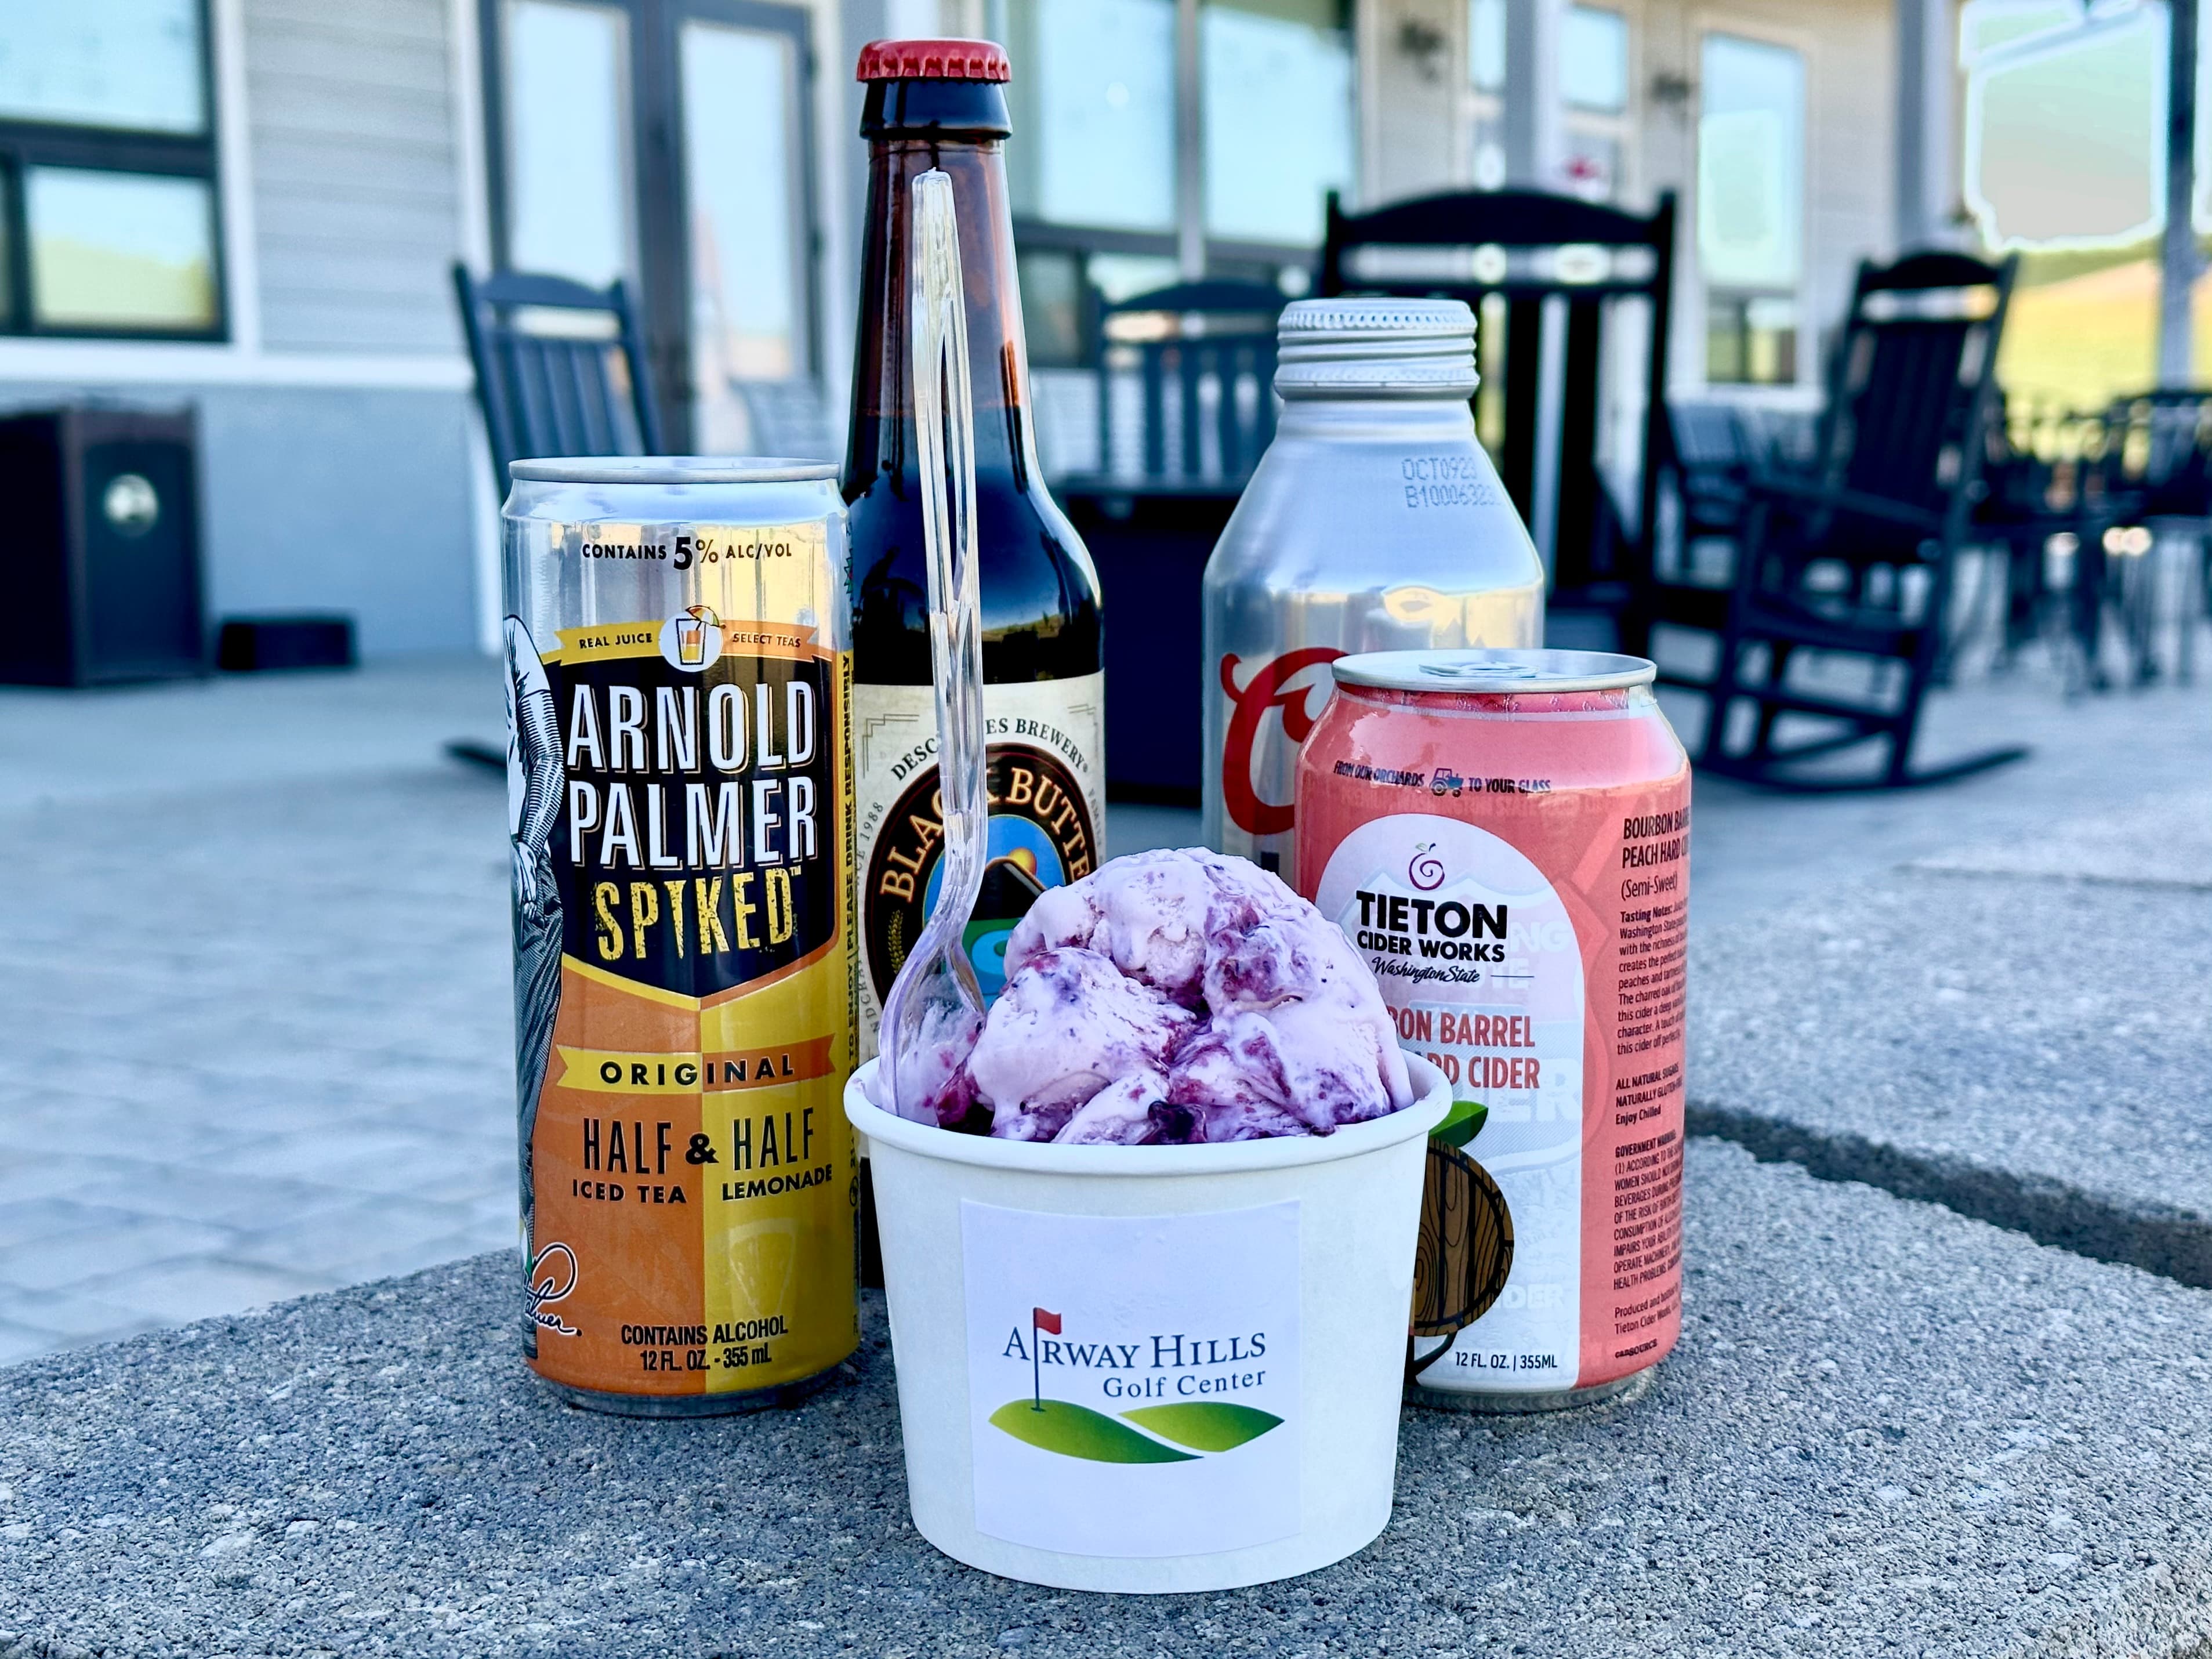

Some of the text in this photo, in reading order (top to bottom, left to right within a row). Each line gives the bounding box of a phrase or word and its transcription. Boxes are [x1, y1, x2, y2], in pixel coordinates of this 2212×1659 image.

[582, 536, 792, 571] CONTAINS 5% ALC/VOL
[579, 632, 653, 650] REAL JUICE
[733, 632, 802, 649] SELECT TEAS
[567, 680, 818, 775] ARNOLD
[843, 654, 853, 796] RESPONSIBLY
[891, 717, 1009, 781] DESCES
[1333, 759, 1551, 794] FROM OUR ORCHARDS TO YOUR GLASS
[568, 776, 818, 870] PALMER
[844, 800, 853, 867] DRINK
[860, 801, 884, 842] 1988
[1623, 812, 1673, 840] BOURBON
[880, 767, 1001, 904] BLA
[1622, 842, 1658, 869] PEACH
[1660, 838, 1680, 864] HARD
[1620, 870, 1678, 901] (Semi-Sweet)
[845, 872, 854, 952] PLEASE
[1355, 890, 1508, 940] TIETON
[1620, 908, 1651, 923] Tasting
[1619, 922, 1662, 940] Washington
[1357, 930, 1506, 963] CIDER WORKS
[1619, 943, 1638, 956] with
[1639, 940, 1652, 953] the
[1619, 959, 1647, 972] creates
[1648, 955, 1659, 968] the
[1618, 974, 1649, 991] peaches
[1651, 969, 1662, 983] and
[1618, 993, 1634, 1006] The
[1635, 988, 1660, 1004] charred
[1618, 1009, 1634, 1022] this
[1635, 1006, 1652, 1019] cider
[1439, 1012, 1536, 1048] BARREL
[1617, 1042, 1633, 1055] this
[1634, 1038, 1652, 1052] cider
[599, 1053, 795, 1086] ORIGINAL
[1467, 1056, 1540, 1089] CIDER
[1615, 1078, 1631, 1091] ALL
[1632, 1070, 1662, 1088] NATURAL
[1616, 1088, 1658, 1108] NATURALLY
[1615, 1104, 1661, 1126] Enjoy Chilled
[583, 1107, 814, 1175] HALF & HALF
[1615, 1136, 1657, 1158] GOVERNMENT
[1626, 1152, 1659, 1173] ACCORDING
[572, 1179, 687, 1204] ICED TEA
[721, 1163, 833, 1202] LEMONADE
[1614, 1175, 1640, 1191] WOMEN
[1614, 1187, 1651, 1208] BEVERAGES
[1614, 1211, 1623, 1225] OF
[1625, 1208, 1637, 1222] THE
[1613, 1217, 1657, 1241] CONSUMPTION
[1613, 1240, 1641, 1257] IMPAIRS
[1613, 1255, 1643, 1274] OPERATE
[1613, 1273, 1638, 1290] HEALTH
[1614, 1299, 1648, 1318] Produced
[621, 1314, 789, 1346] CONTAINS ALCOHOL
[1614, 1318, 1639, 1335] Tieton
[640, 1350, 658, 1371] 12
[660, 1350, 683, 1371] FL.
[686, 1348, 711, 1371] OZ.
[723, 1346, 749, 1369] 355
[1455, 1351, 1558, 1370] 12 FL. OZ. 355ML
[1103, 1369, 1266, 1399] Golf Center
